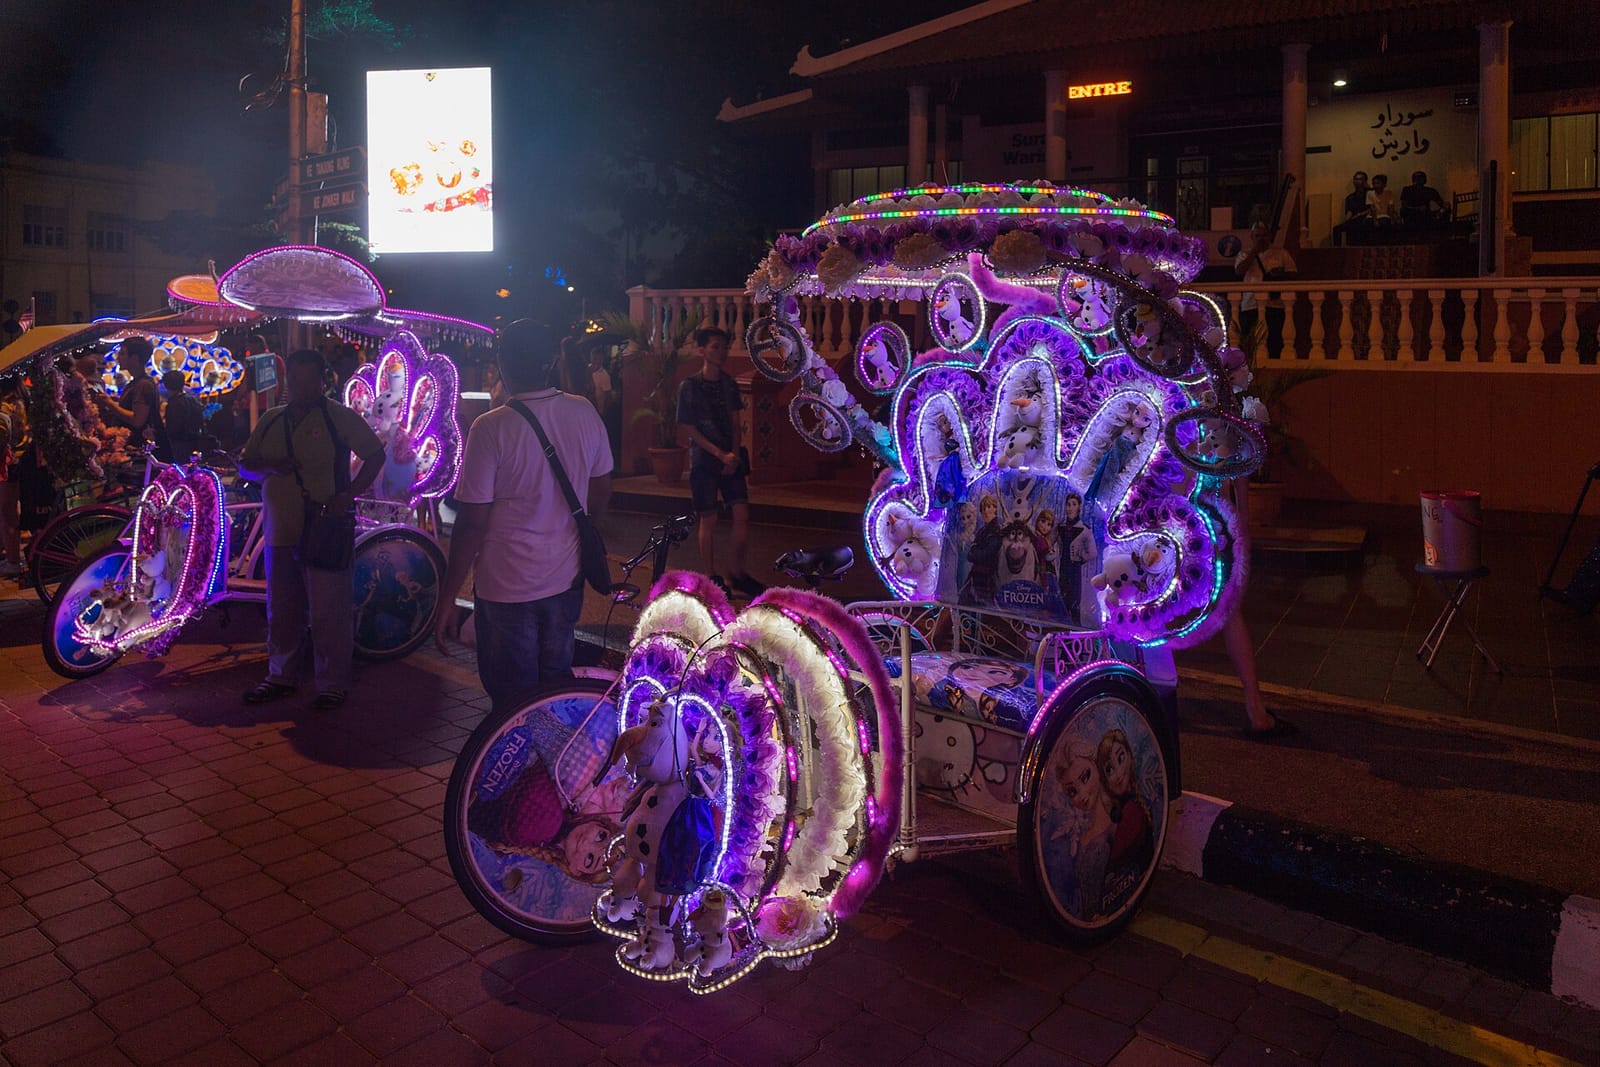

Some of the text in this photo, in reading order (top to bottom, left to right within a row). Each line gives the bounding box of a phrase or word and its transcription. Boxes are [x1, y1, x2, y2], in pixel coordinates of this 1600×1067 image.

[1067, 80, 1133, 99] ENTRE
[1011, 132, 1046, 148] Sur
[1003, 589, 1045, 605] FROZEN
[481, 731, 527, 793] FROZEN
[1102, 870, 1136, 912] FROZEN
